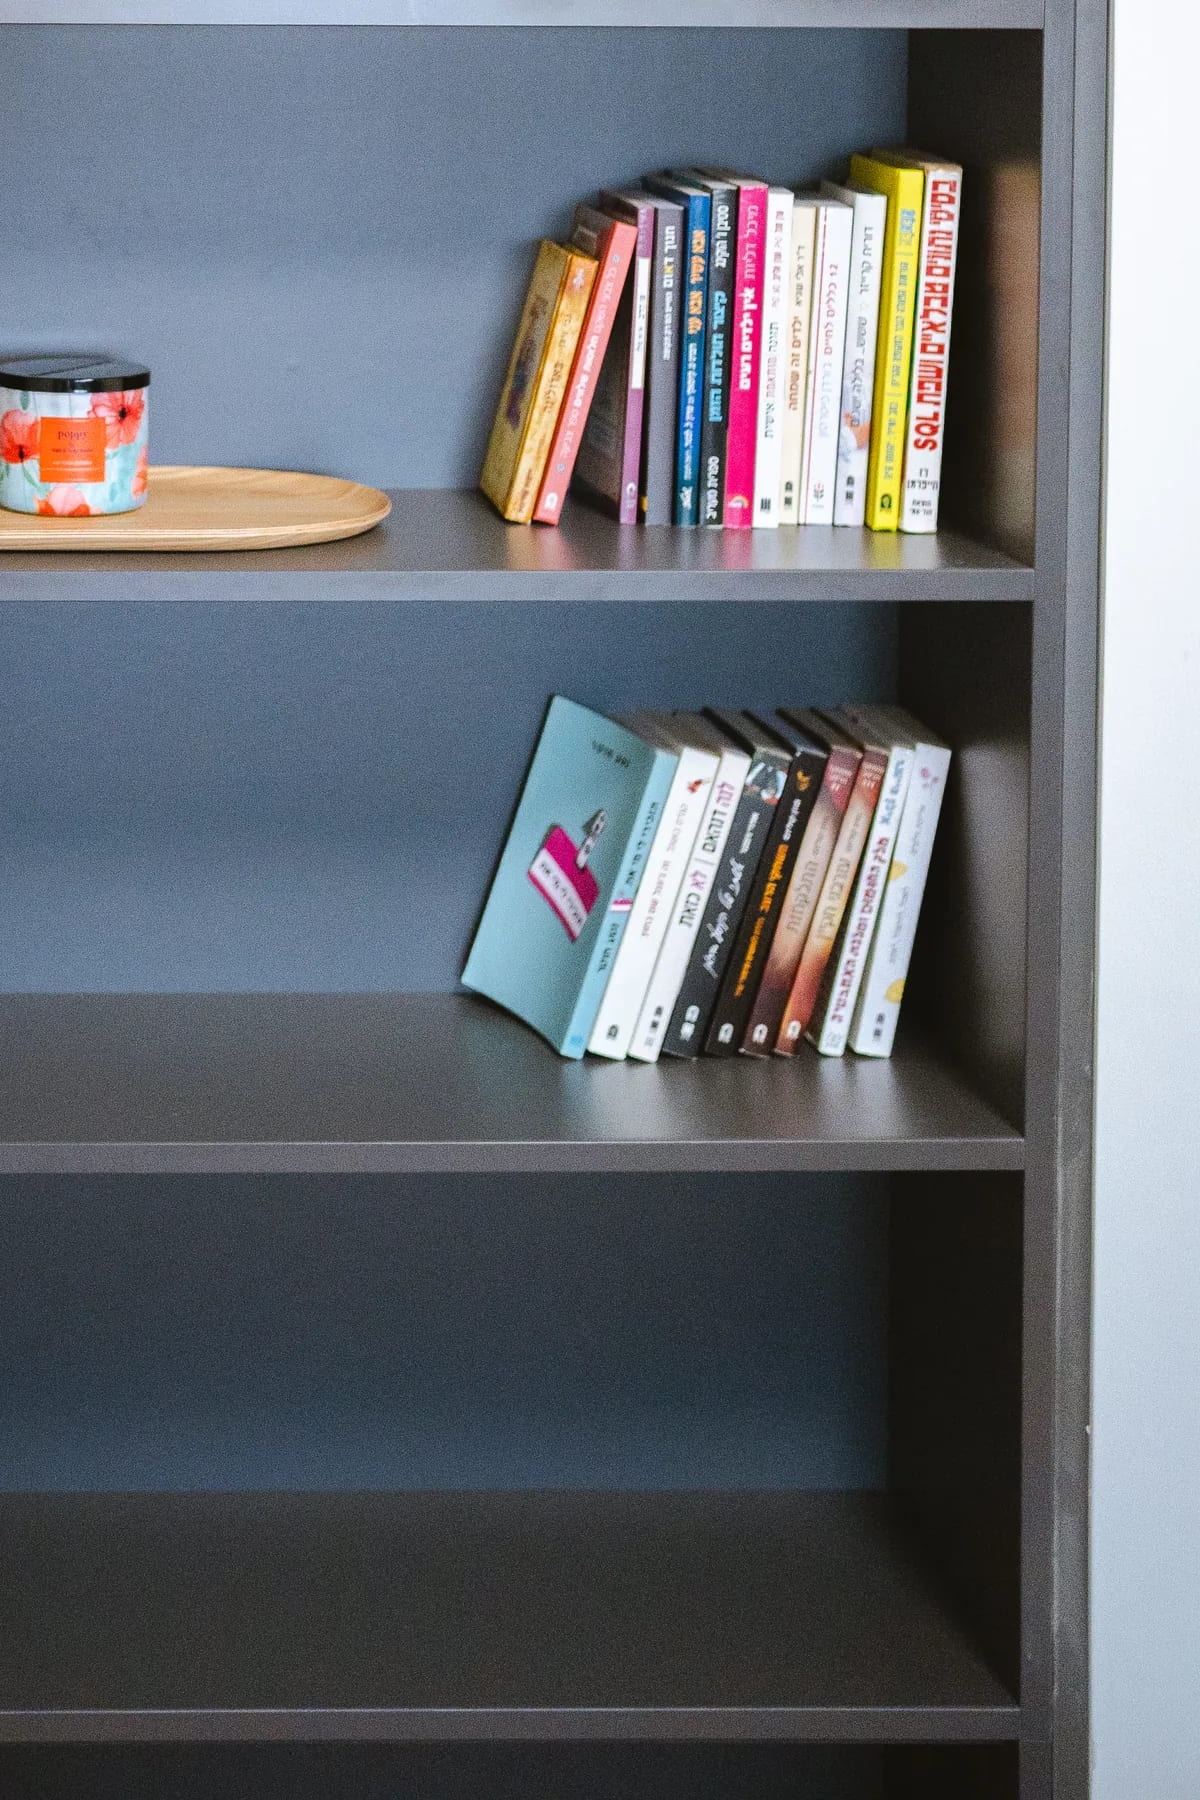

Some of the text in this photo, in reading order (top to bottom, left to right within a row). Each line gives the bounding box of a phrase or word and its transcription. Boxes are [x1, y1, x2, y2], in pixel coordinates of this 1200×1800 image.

[662, 256, 675, 287] דאום
[689, 228, 706, 314] אבא אבא
[738, 204, 759, 389] מיכל דליות אין ילדים רעים
[821, 282, 836, 355] כללים לחיים
[912, 179, 957, 450] בסיסי נתונים טבלאיים ושפת SQL
[790, 315, 802, 367] ילדים זה
[849, 357, 864, 391] בלילה
[763, 402, 775, 438] אישית
[712, 780, 736, 808] לנה
[700, 807, 727, 853] דנהאם
[687, 868, 708, 891] לא
